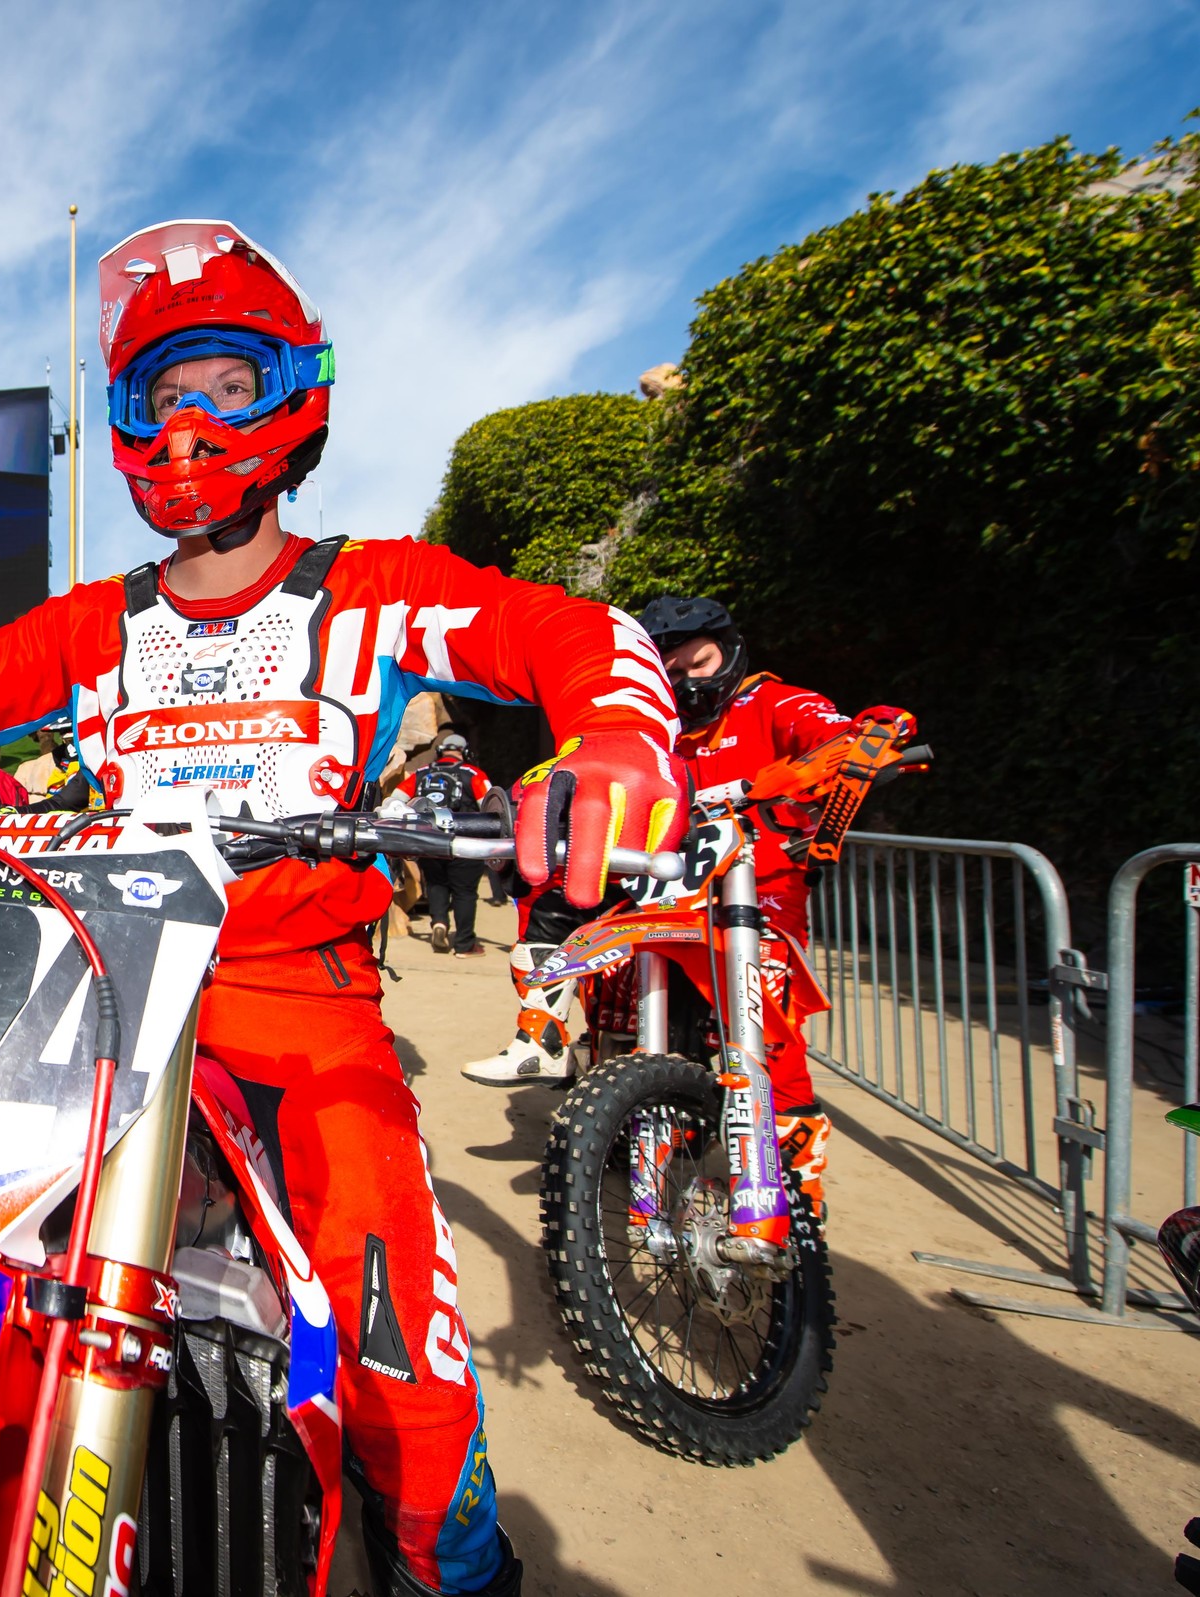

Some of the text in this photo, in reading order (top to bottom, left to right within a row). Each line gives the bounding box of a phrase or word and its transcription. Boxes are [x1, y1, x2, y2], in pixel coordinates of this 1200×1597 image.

[189, 620, 237, 638] AMA
[145, 717, 307, 746] HONDA
[180, 764, 256, 781] GRINGA
[131, 882, 159, 897] FIM
[586, 949, 623, 971] FLO
[757, 1075, 779, 1184] REKLUSE
[360, 1355, 412, 1383] CIRCUIT
